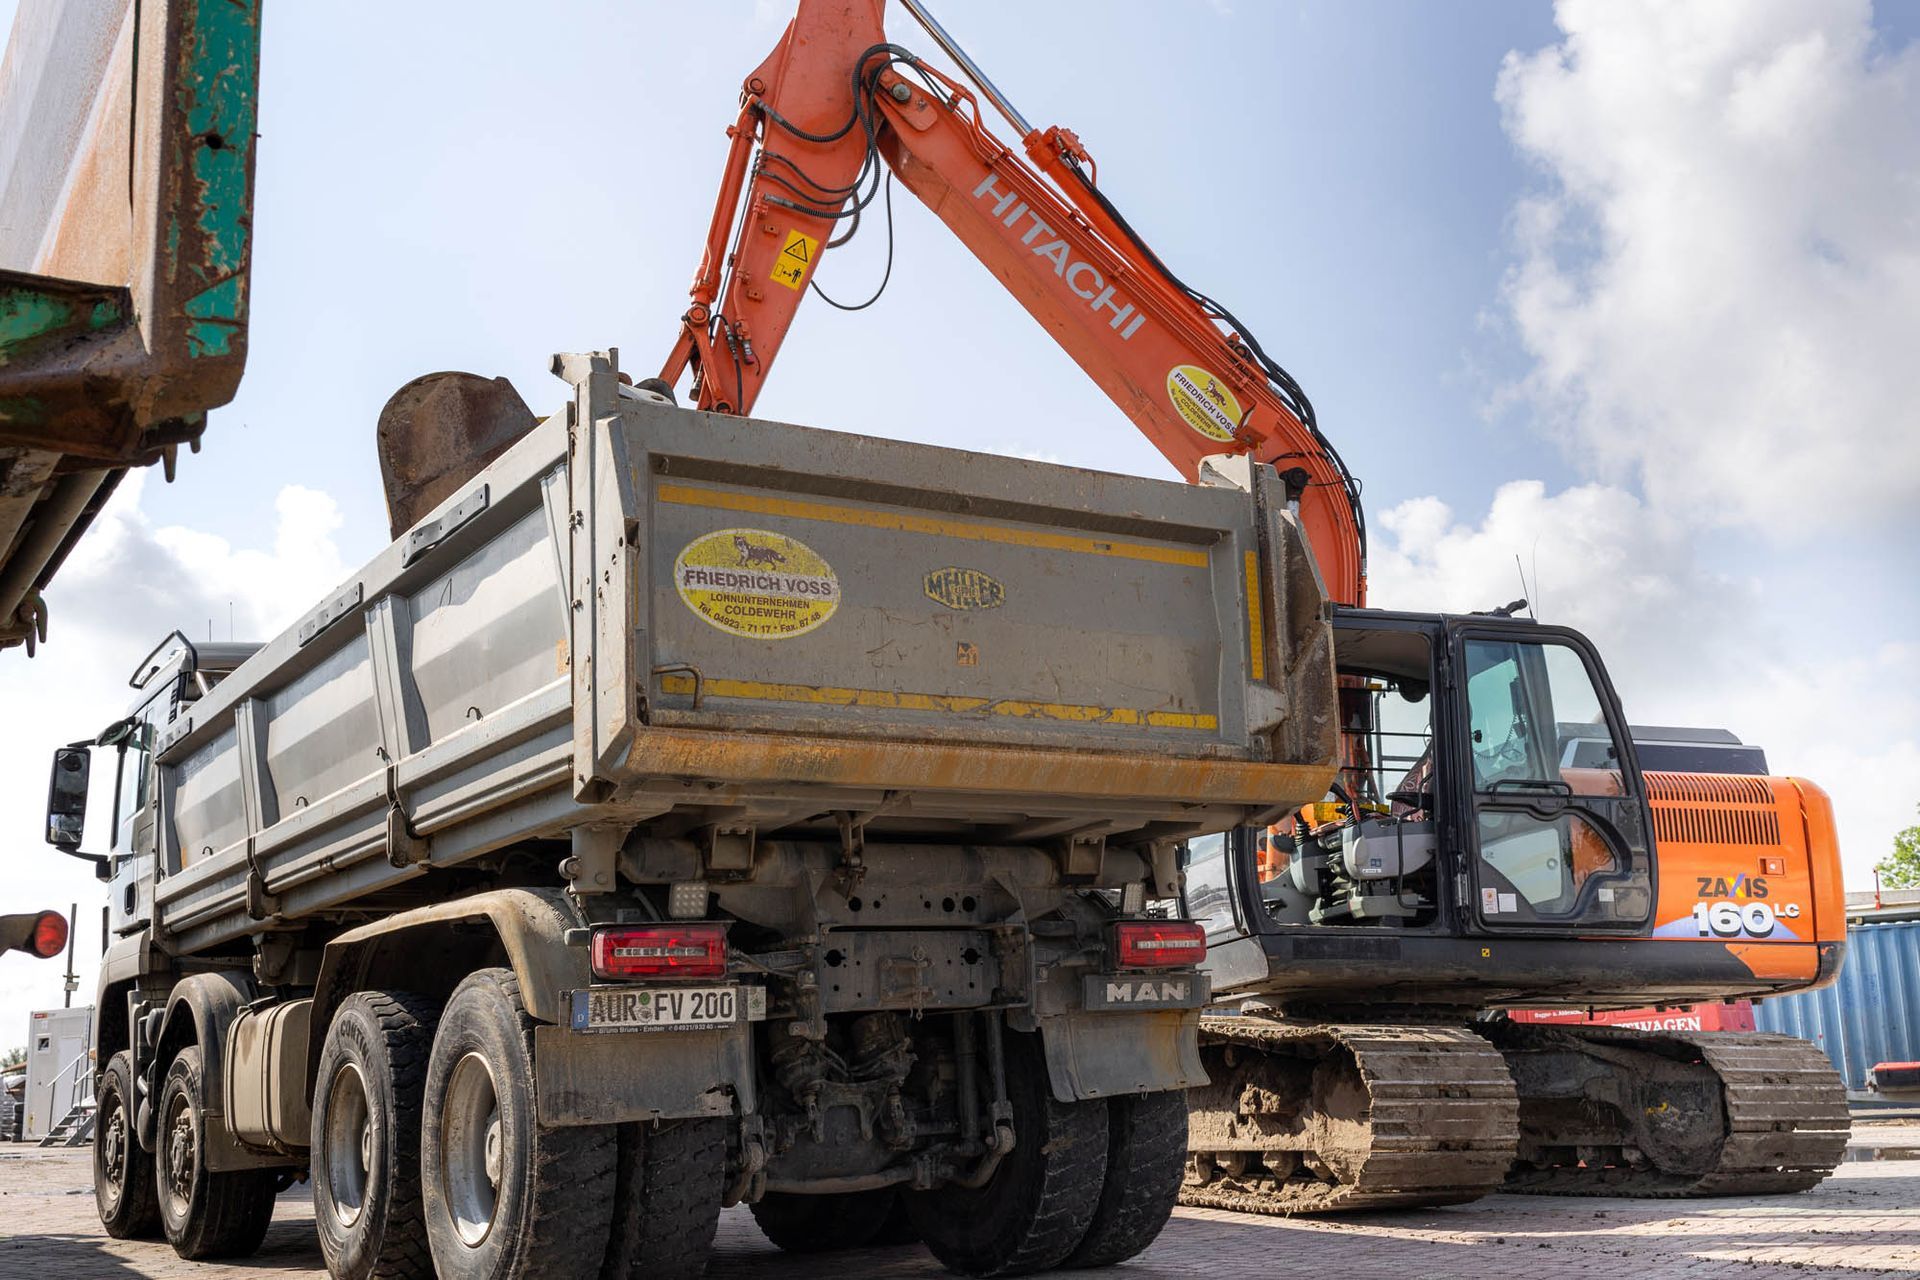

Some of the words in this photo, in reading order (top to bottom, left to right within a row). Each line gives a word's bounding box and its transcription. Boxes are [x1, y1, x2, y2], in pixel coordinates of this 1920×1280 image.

[972, 173, 1146, 340] HITACHI
[1174, 372, 1216, 414] FRIEDRICH
[1180, 398, 1212, 429] COLDEWEHR
[685, 569, 781, 591] FRIEDRICH
[785, 578, 832, 596] VOSS
[710, 592, 810, 609] LOHNUNTERNEHMEN
[724, 605, 796, 620] COLDEWEHR
[699, 602, 712, 617] Tel.
[713, 612, 740, 629] 04923
[761, 625, 771, 633] 17
[780, 624, 798, 633] Fax.
[1697, 873, 1769, 898] ZAXIS
[1106, 982, 1185, 1002] MAN
[577, 1013, 584, 1023] D
[591, 992, 637, 1023] AUR
[655, 993, 683, 1021] FV
[691, 991, 733, 1019] 200
